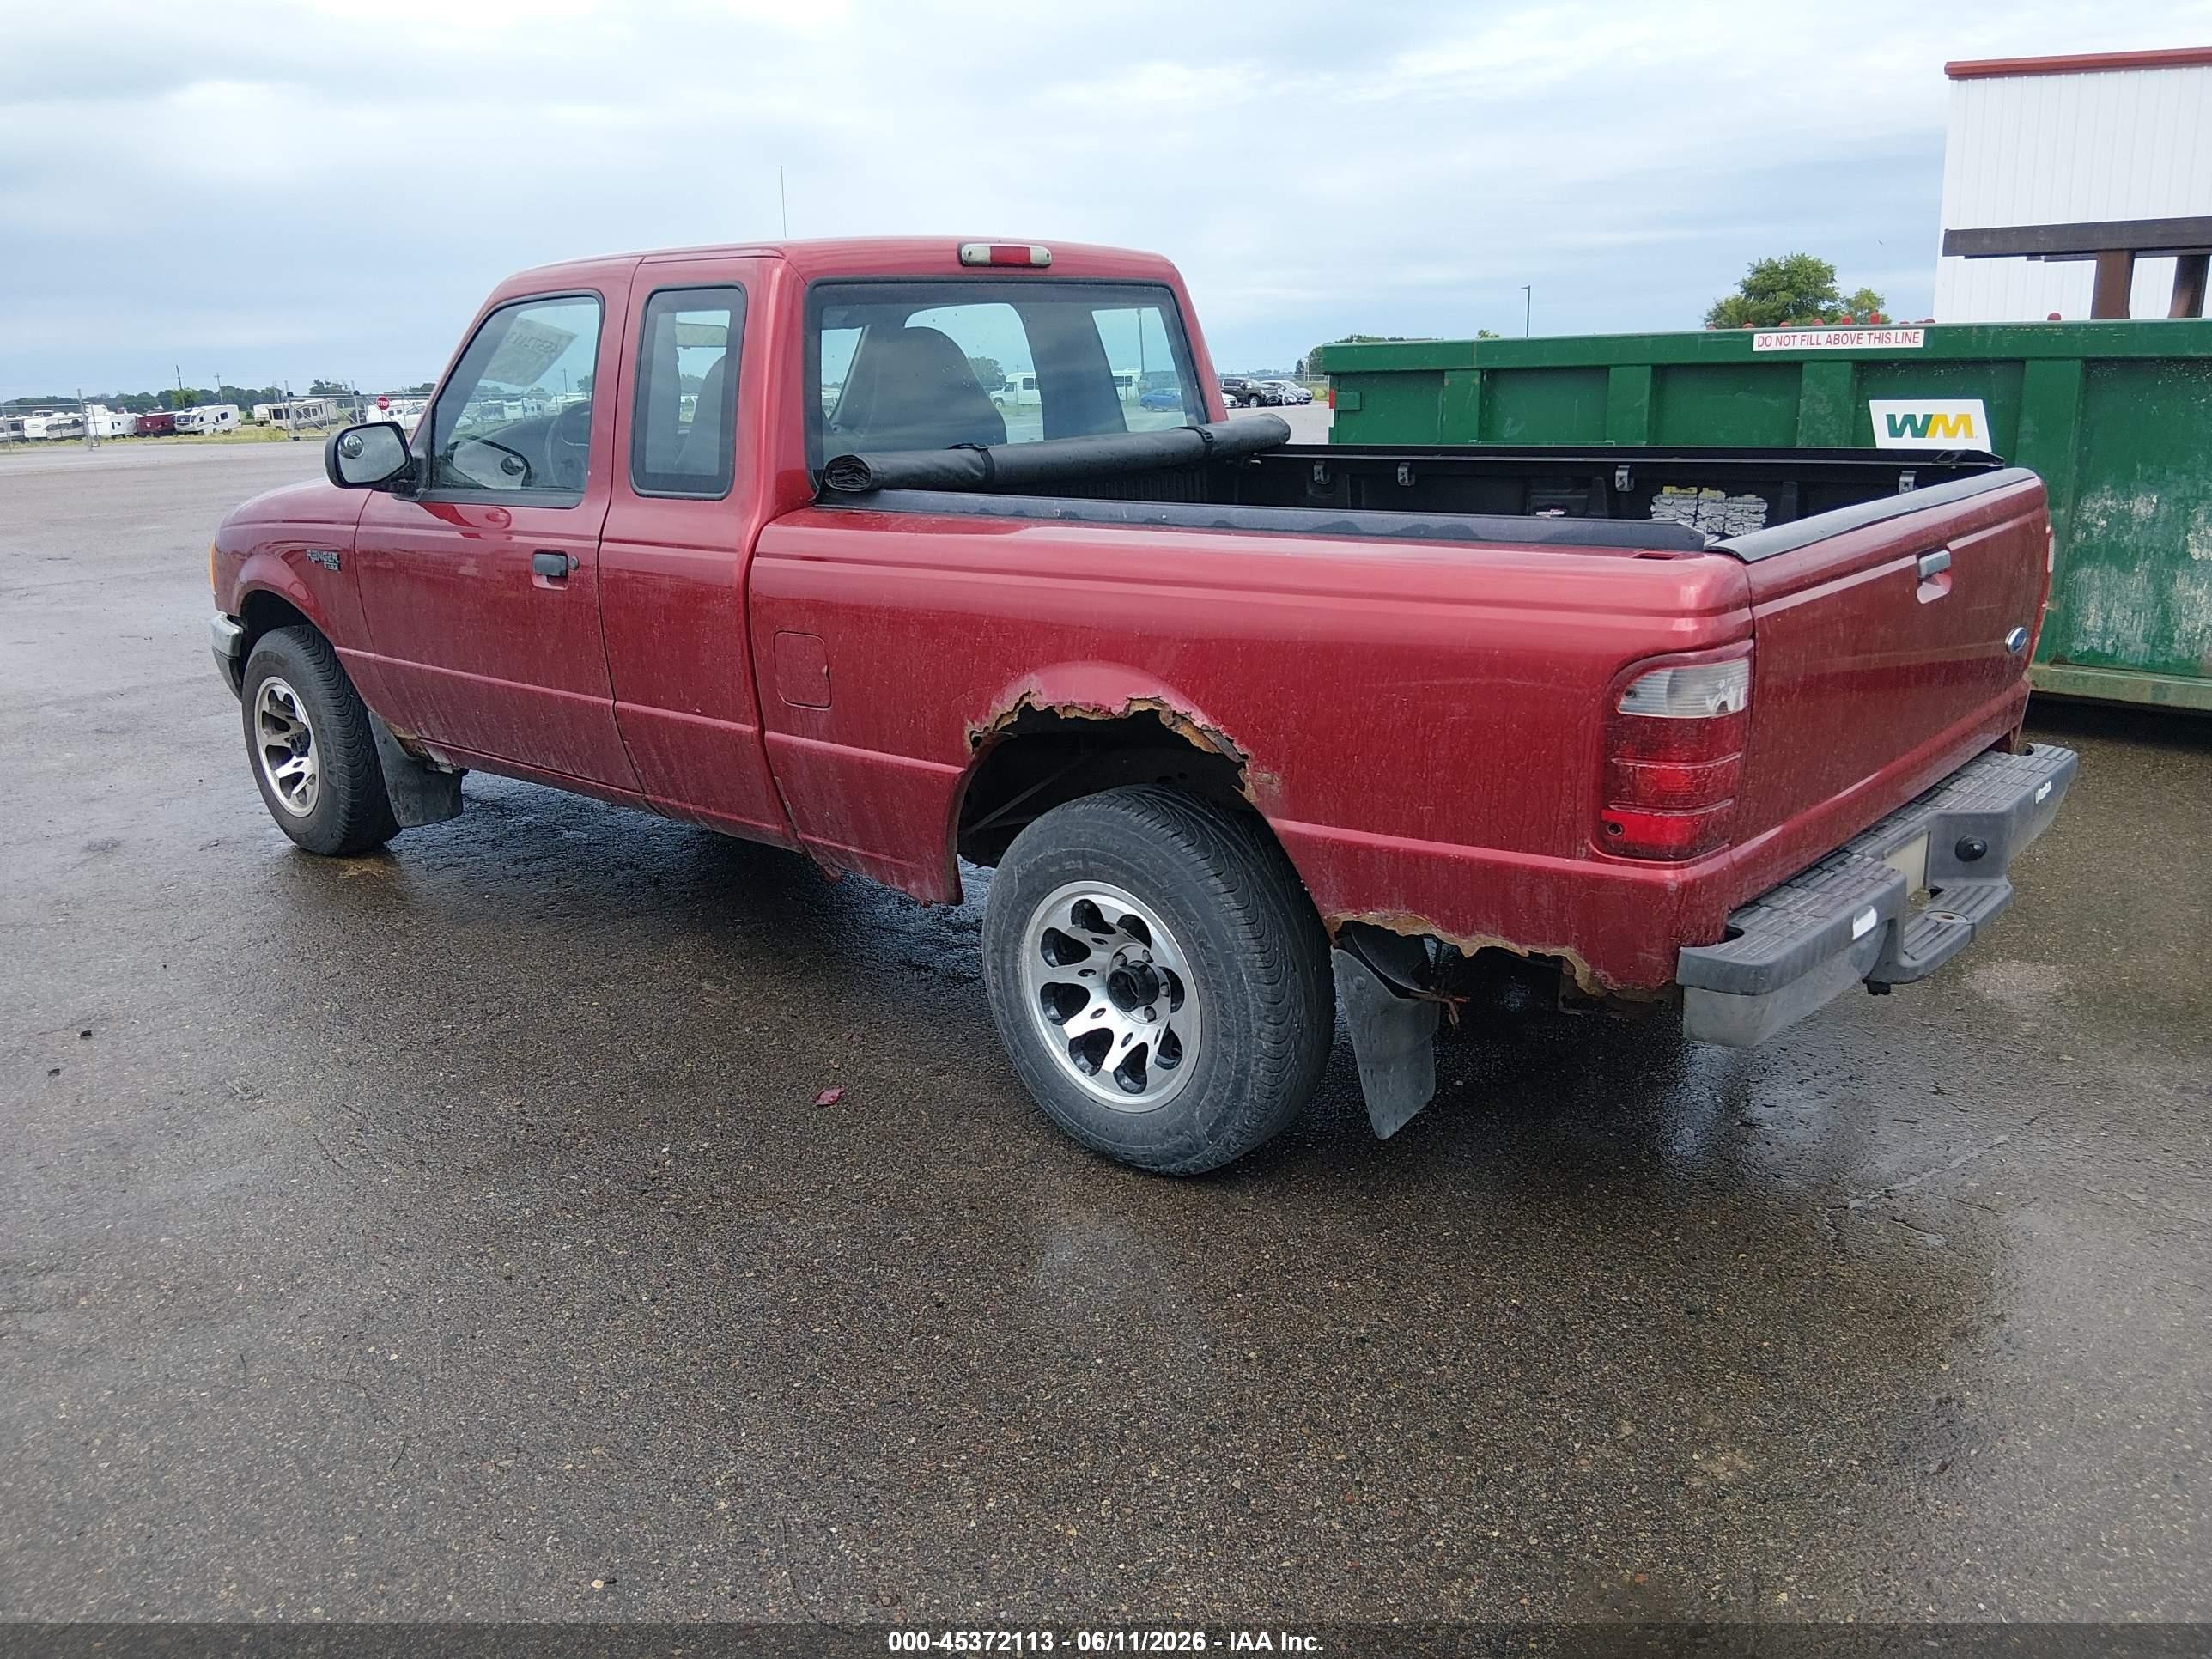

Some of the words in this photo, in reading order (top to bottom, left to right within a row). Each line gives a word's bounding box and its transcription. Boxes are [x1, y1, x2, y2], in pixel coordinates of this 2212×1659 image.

[1757, 335, 1772, 348] DO
[1775, 334, 1797, 347] NOT
[1800, 334, 1822, 346] FILL
[1825, 332, 1863, 345] ABOVE
[1867, 331, 1892, 344] THIS
[1894, 331, 1920, 344] LINE
[1885, 413, 1974, 439] WM
